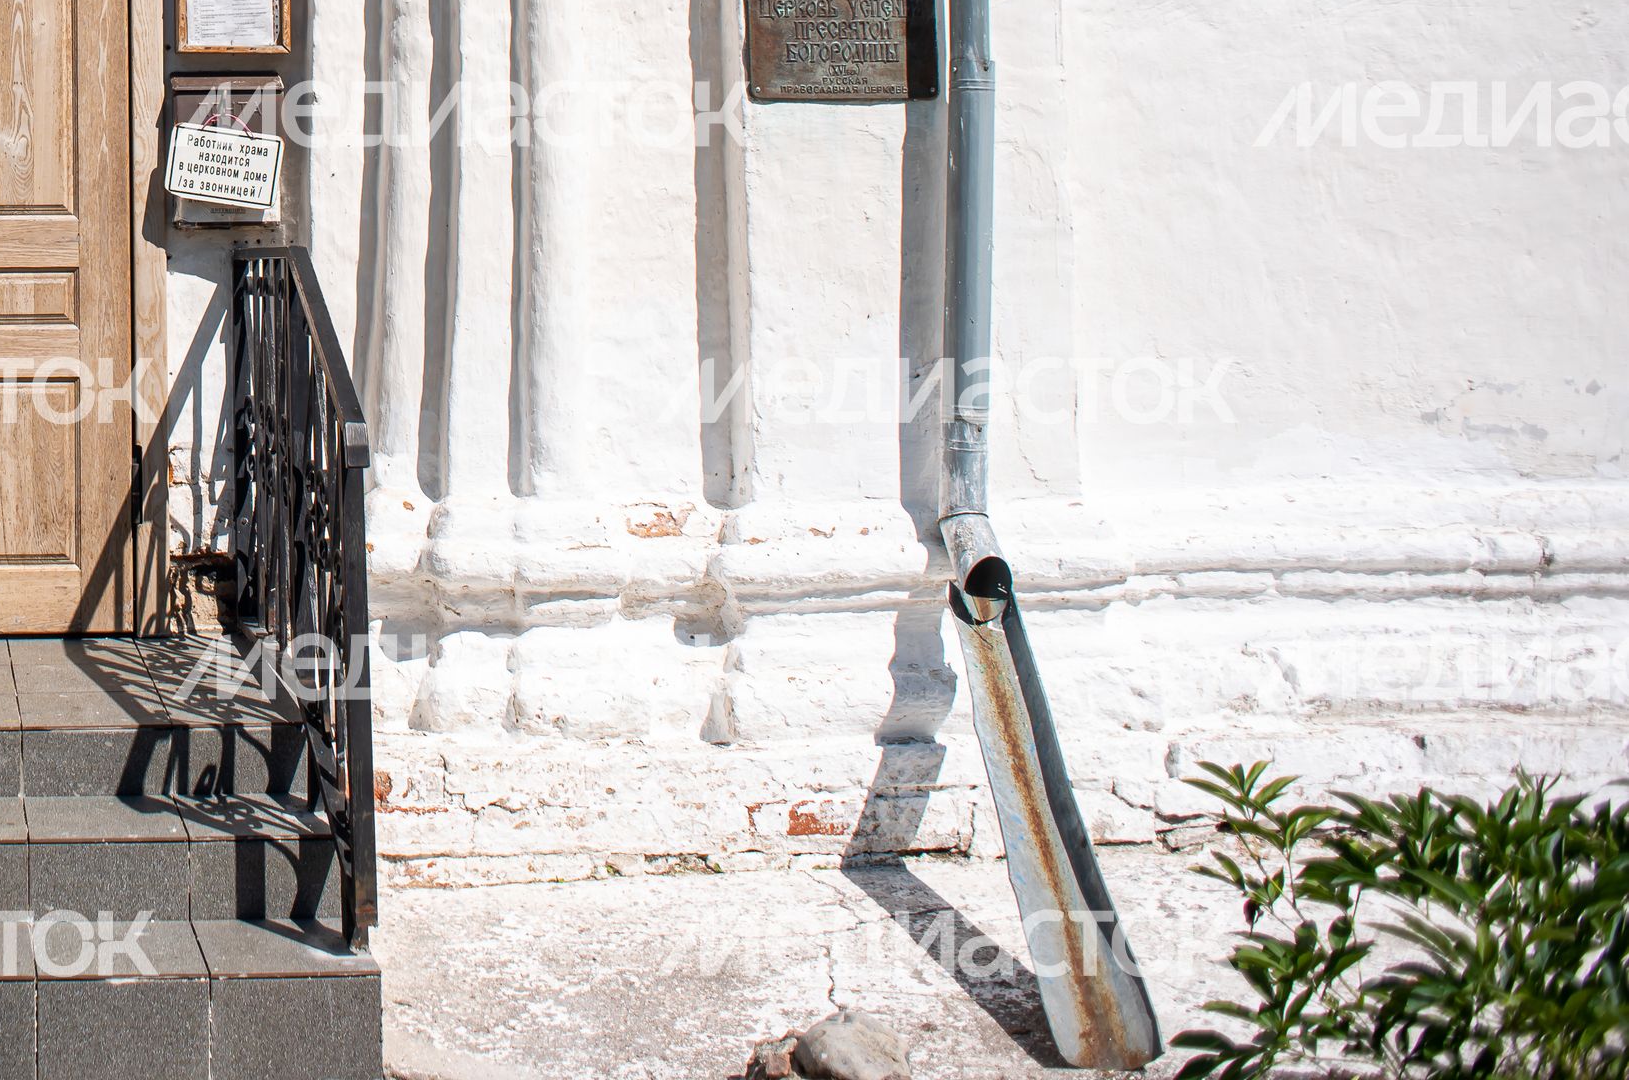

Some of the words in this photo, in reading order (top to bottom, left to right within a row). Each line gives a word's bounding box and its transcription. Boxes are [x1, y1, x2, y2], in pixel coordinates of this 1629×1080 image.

[785, 42, 900, 64] БОГОРОДИЦЫ
[780, 85, 859, 94] ПРАВОСЛАВНАЯ
[864, 85, 908, 94] ЦЕРКОВЬ
[822, 76, 868, 85] РУССКАЯ
[187, 134, 233, 152] Работник
[239, 144, 269, 157] храма
[199, 151, 250, 167] находится
[179, 161, 184, 170] в
[187, 163, 239, 178] церковном
[243, 172, 268, 182] доме
